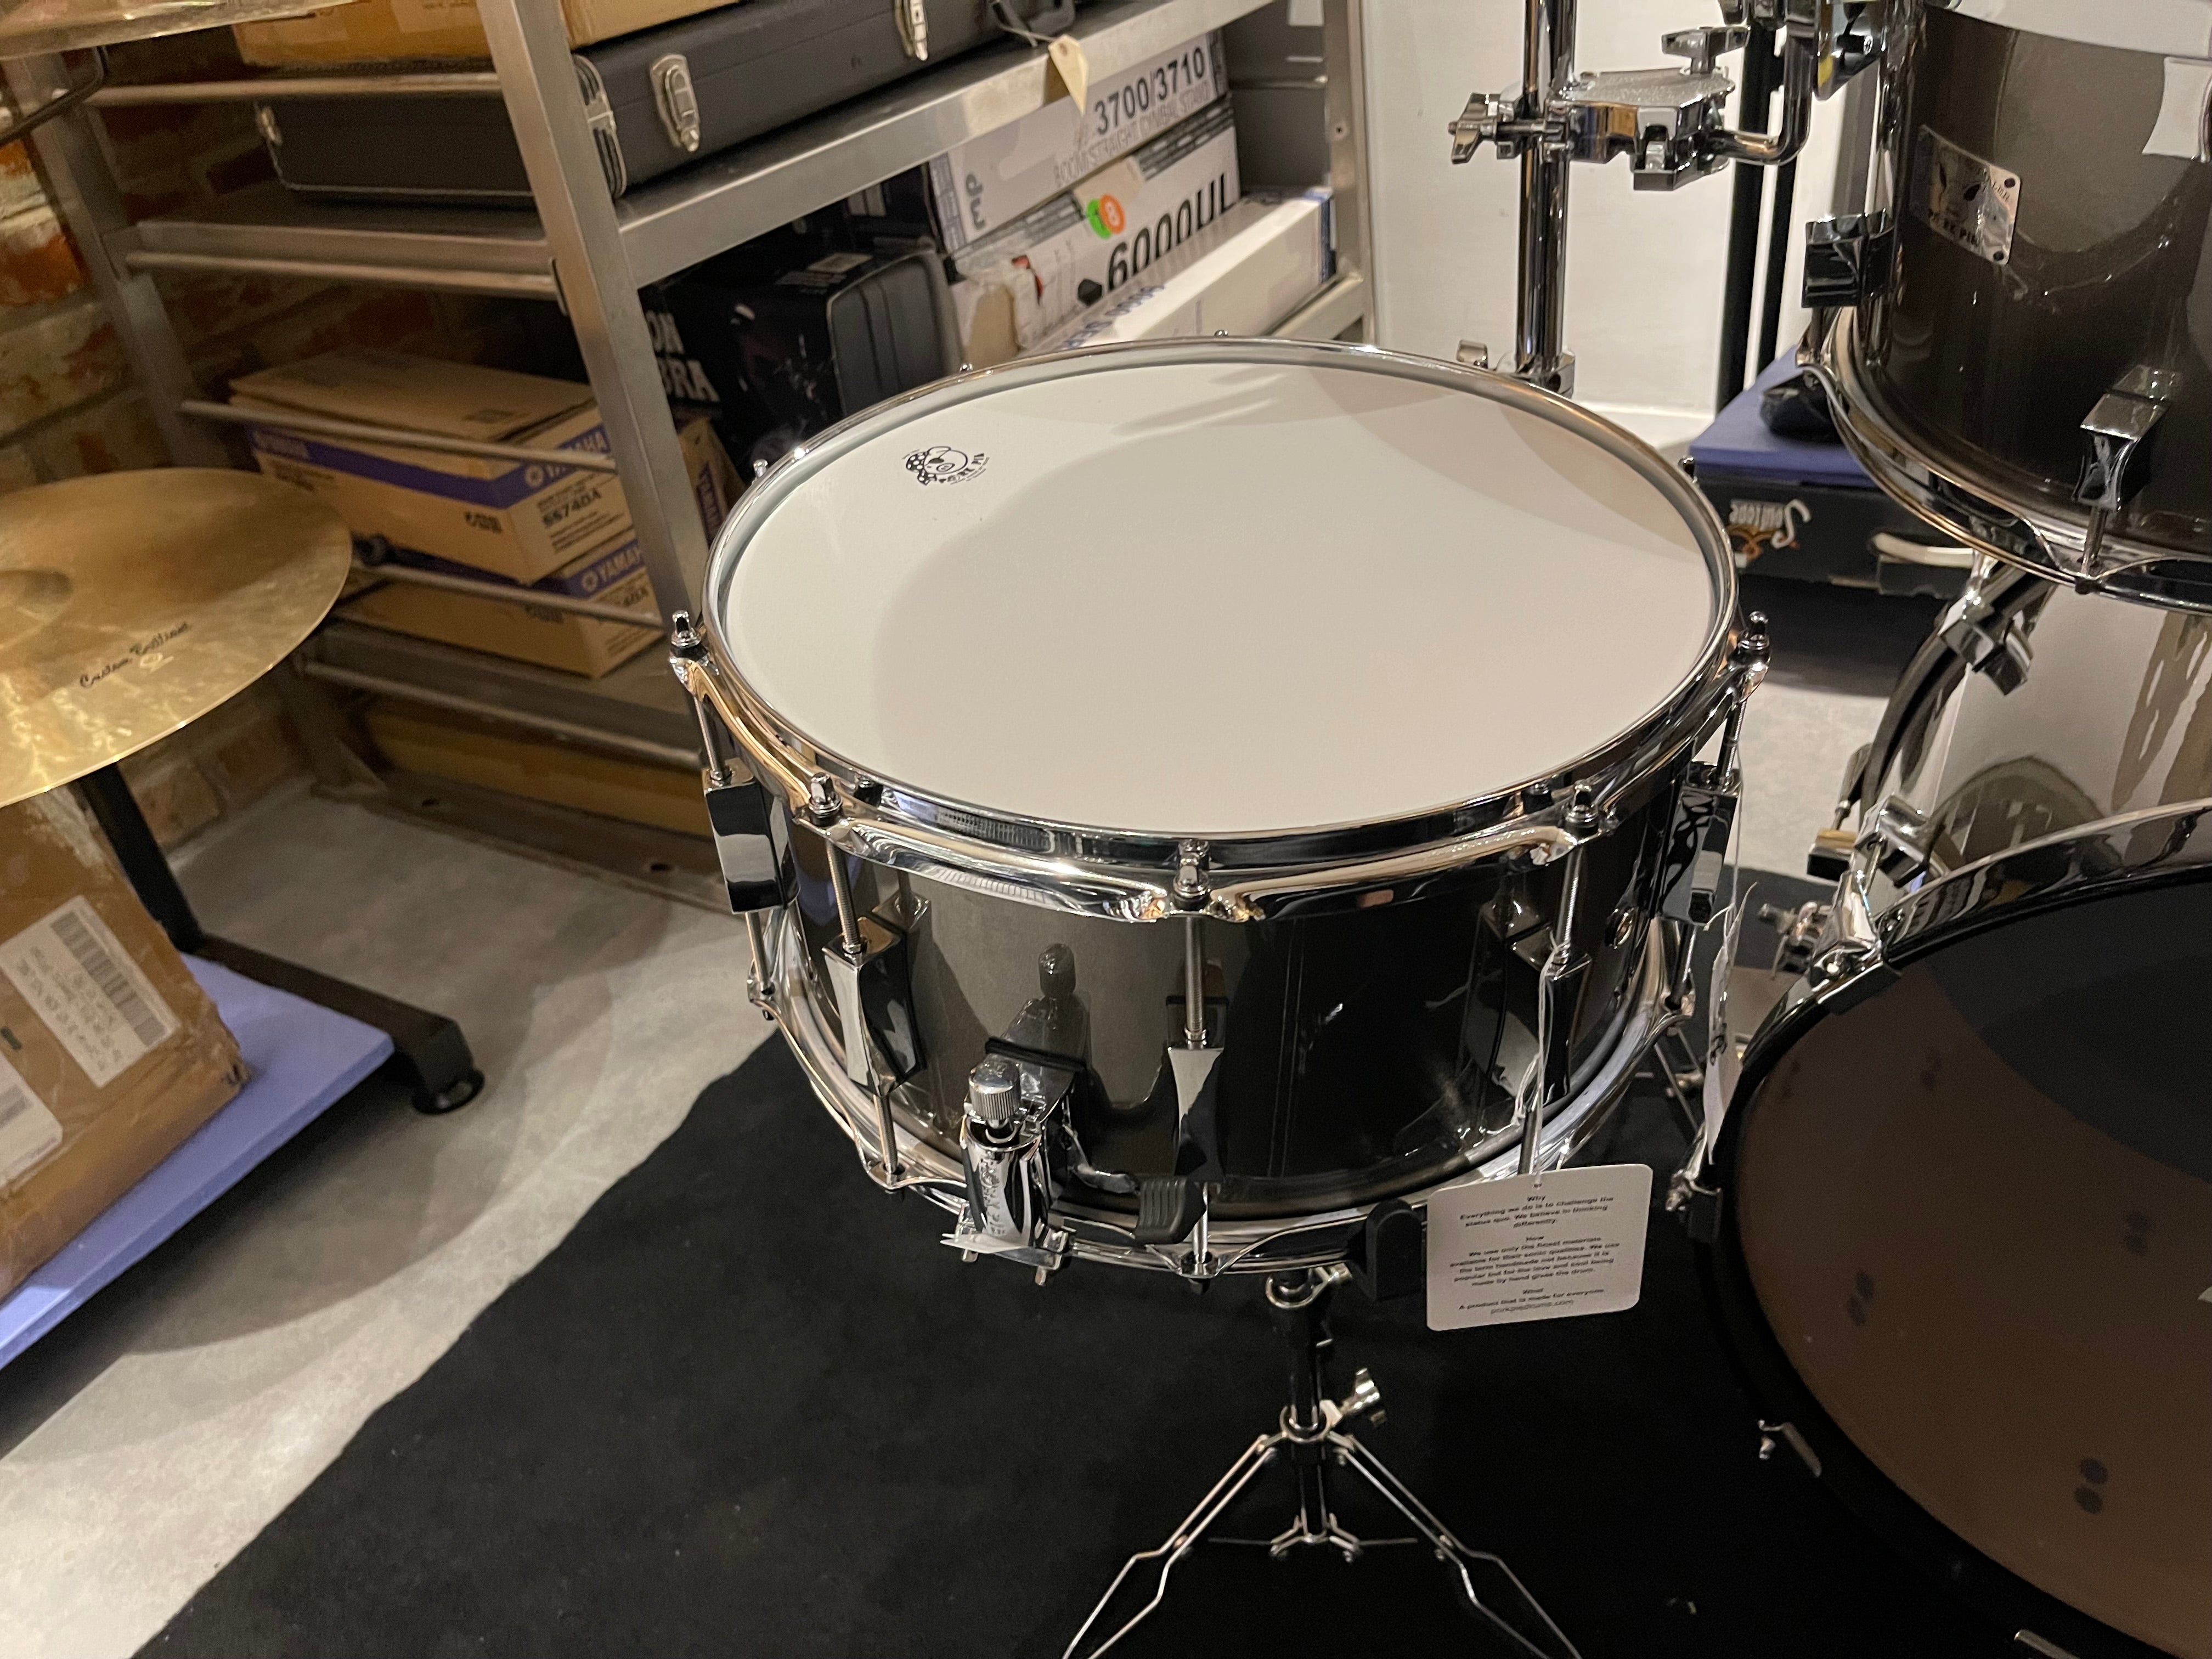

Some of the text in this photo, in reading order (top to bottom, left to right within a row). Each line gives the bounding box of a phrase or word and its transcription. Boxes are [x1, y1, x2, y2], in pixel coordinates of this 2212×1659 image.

[1095, 46, 1206, 136] 3700/3710
[1108, 172, 1237, 291] 6000UL
[1460, 1209, 1505, 1219] Everything
[1556, 1198, 1597, 1207] challenge
